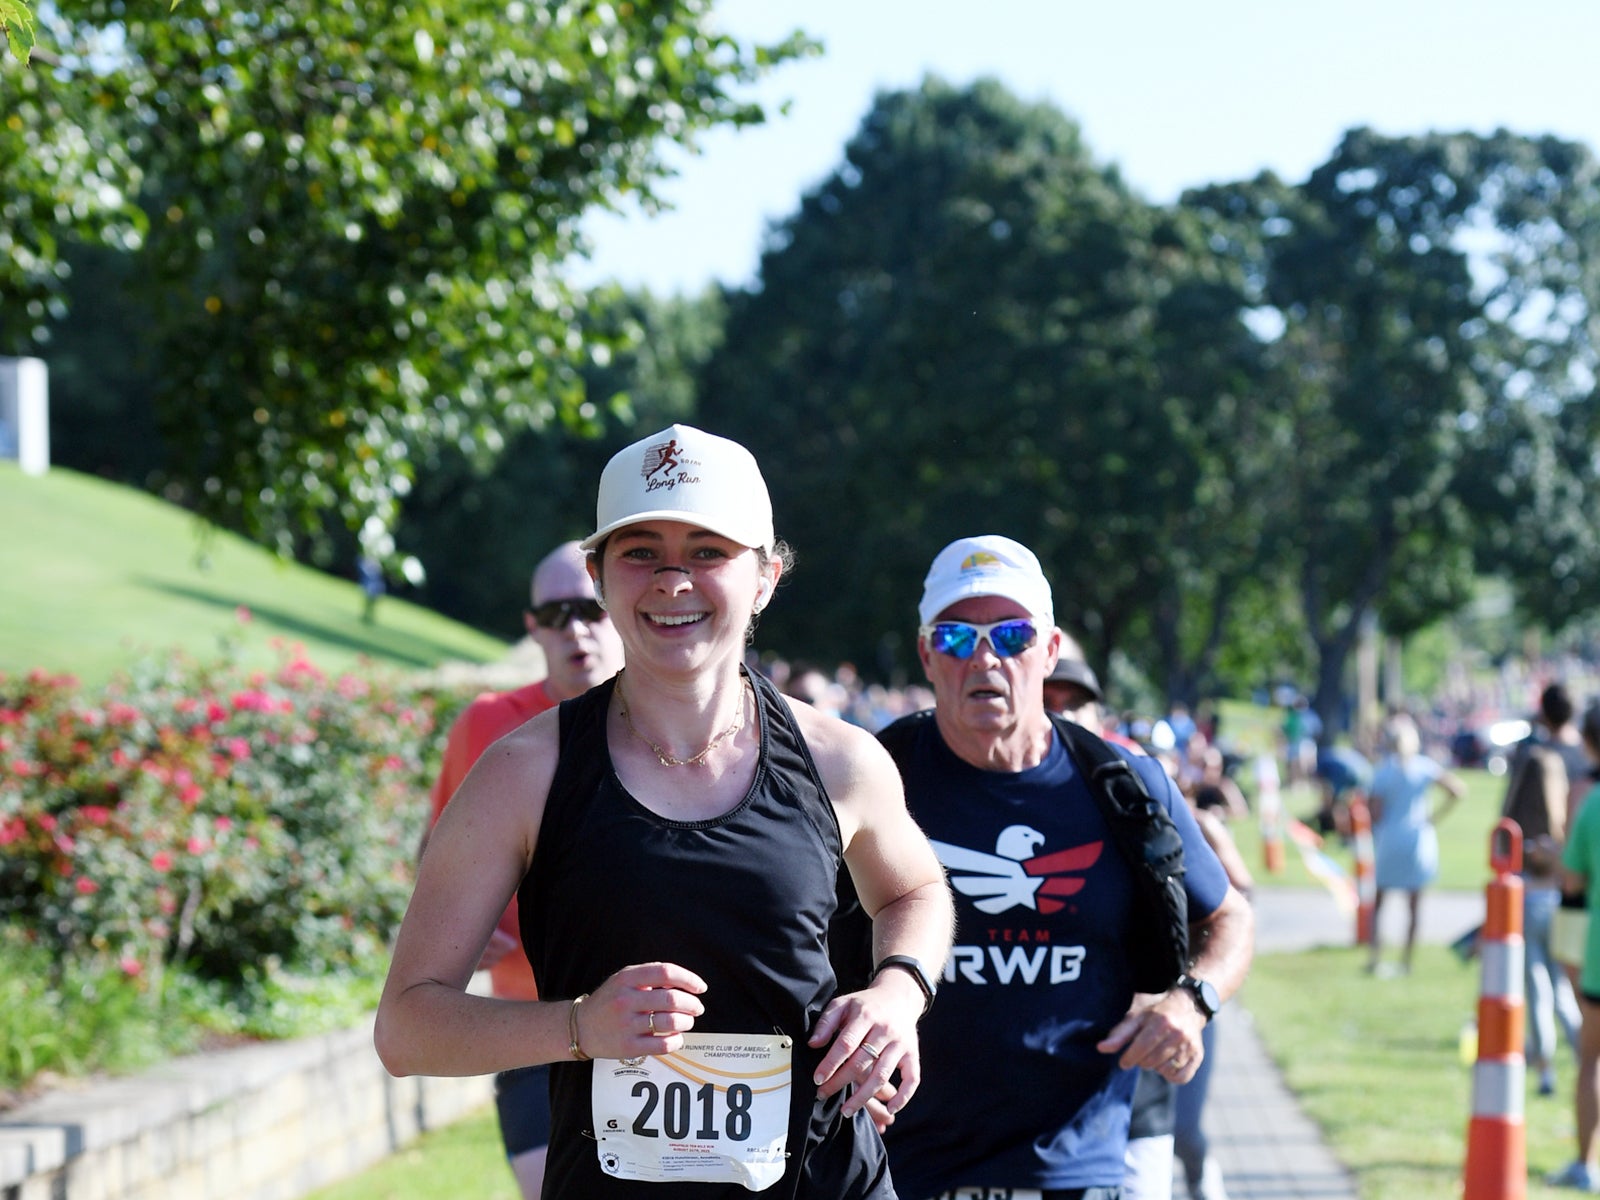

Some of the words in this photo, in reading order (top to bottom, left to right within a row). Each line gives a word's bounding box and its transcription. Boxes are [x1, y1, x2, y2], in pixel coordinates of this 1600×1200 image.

[645, 478, 676, 493] Long
[677, 471, 700, 484] Run
[987, 928, 1051, 942] TEAM
[704, 1051, 750, 1059] CHAMPIONSHIP
[631, 1080, 753, 1142] 2018
[606, 1119, 618, 1129] G
